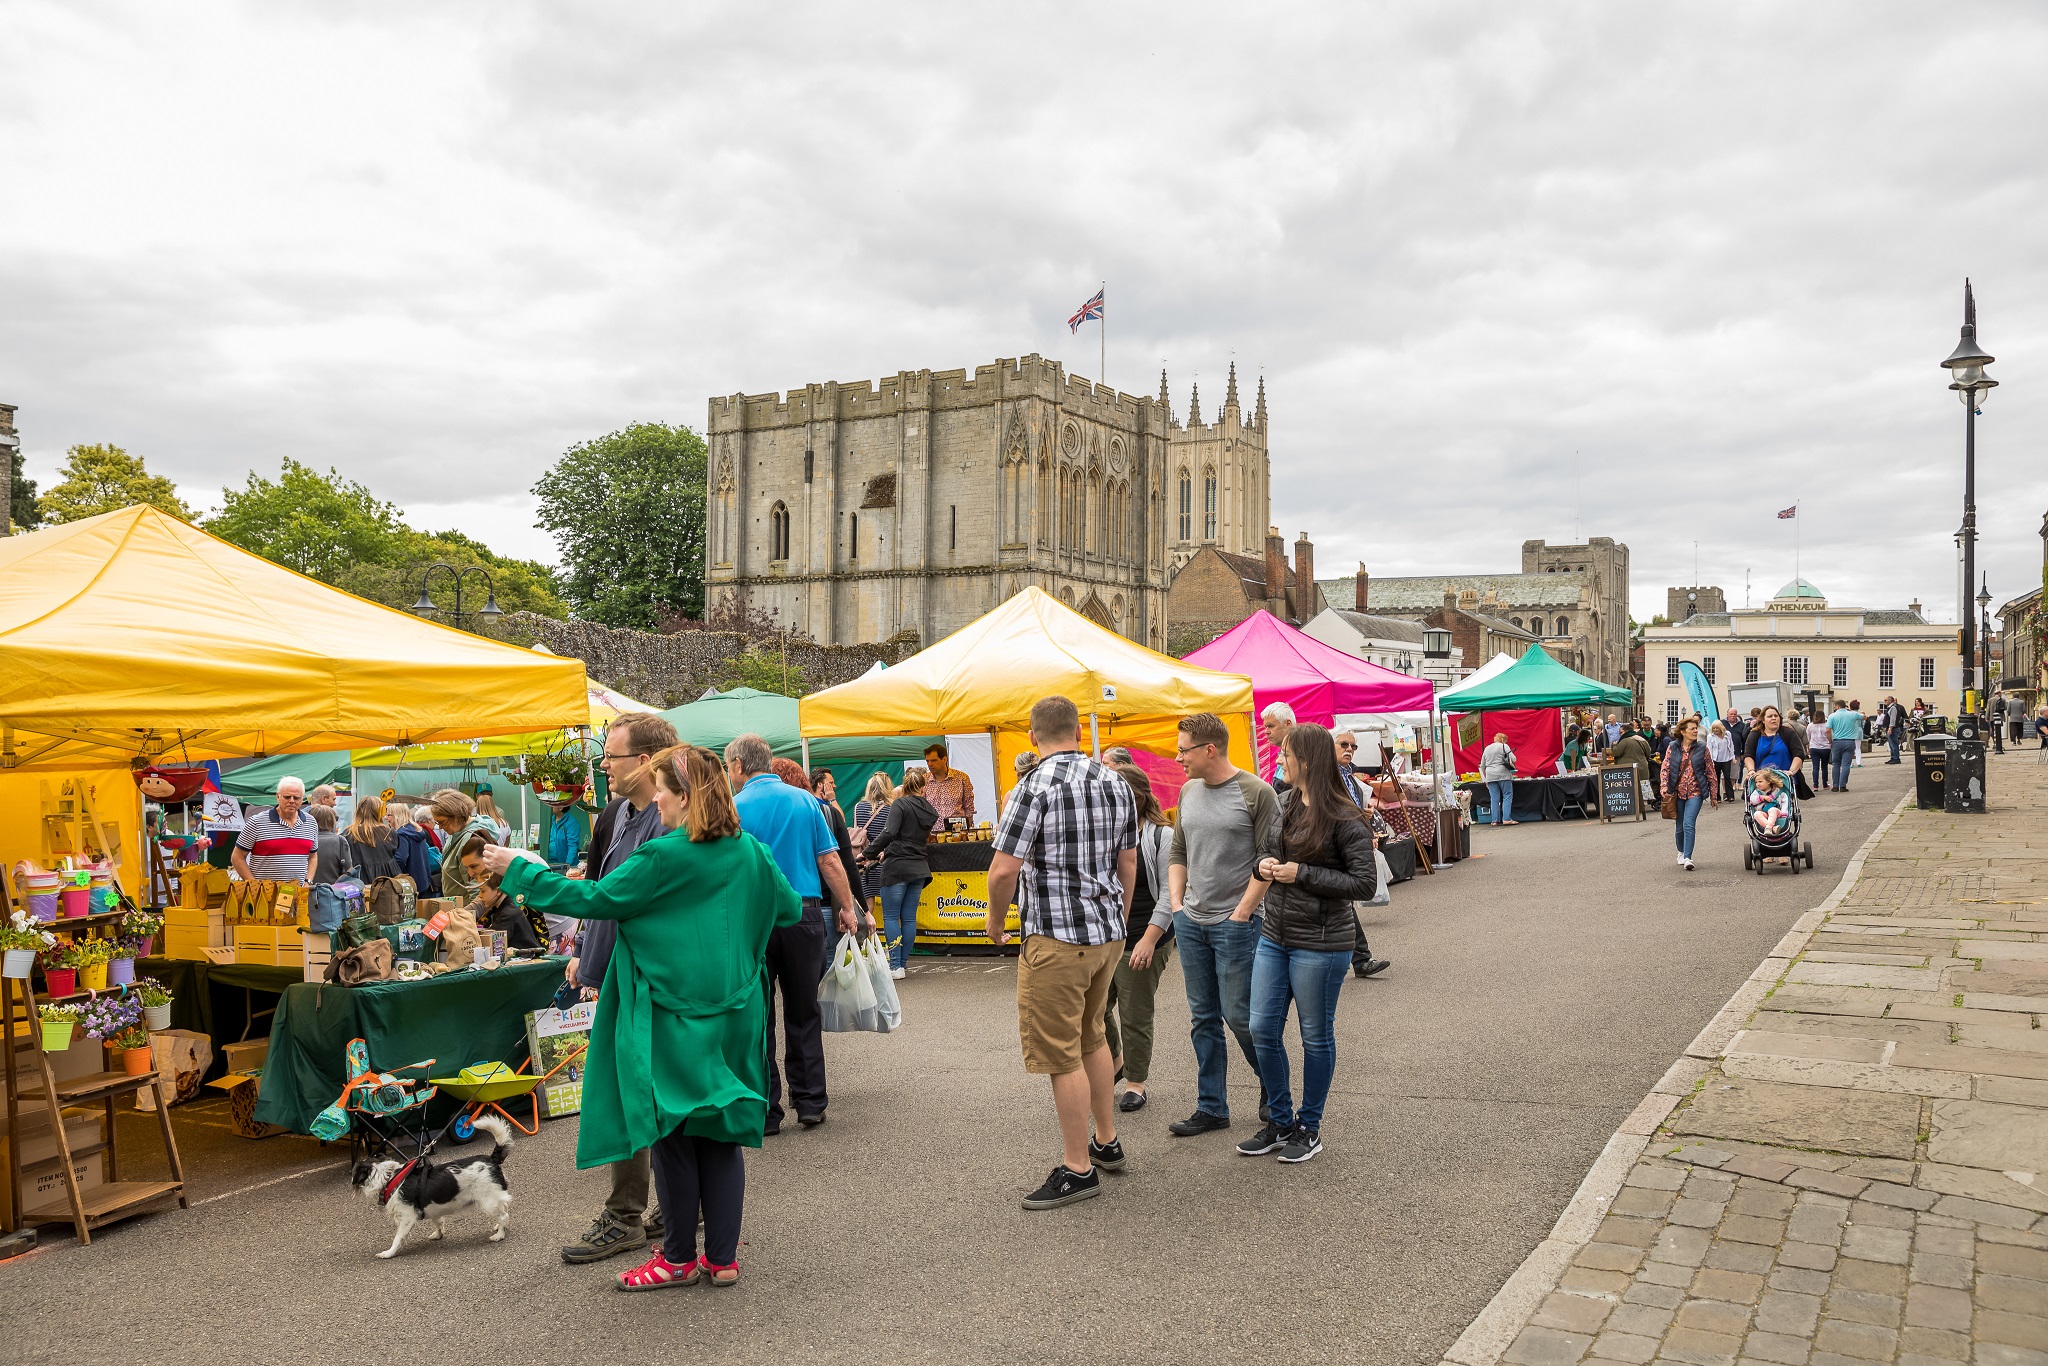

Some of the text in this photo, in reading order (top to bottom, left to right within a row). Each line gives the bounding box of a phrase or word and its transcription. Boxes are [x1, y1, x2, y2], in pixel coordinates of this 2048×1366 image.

[1767, 603, 1826, 611] ATHENÆUM
[1604, 771, 1631, 780] CHEESE
[936, 894, 988, 909] Beehouse
[938, 910, 987, 918] Honey Company
[562, 1007, 586, 1022] kids
[37, 1175, 54, 1184] ITEM
